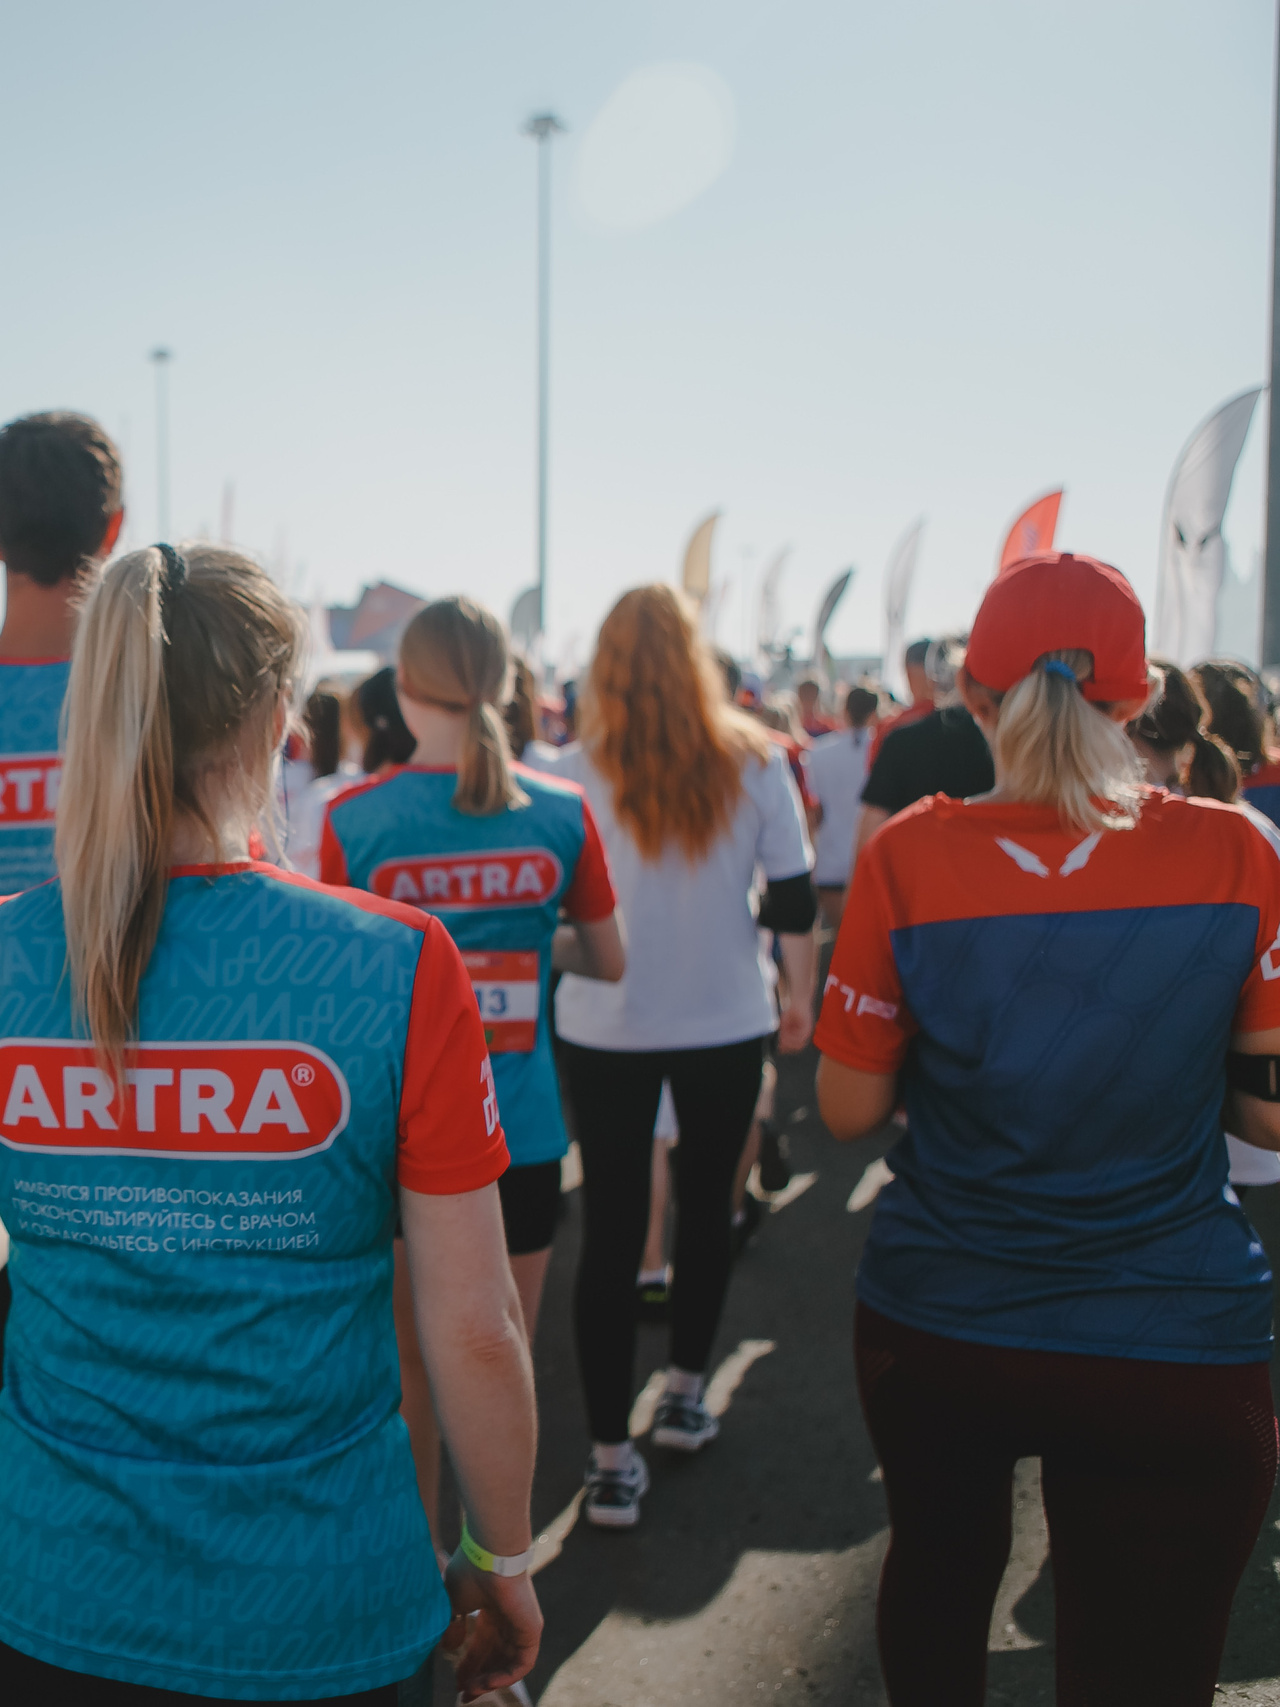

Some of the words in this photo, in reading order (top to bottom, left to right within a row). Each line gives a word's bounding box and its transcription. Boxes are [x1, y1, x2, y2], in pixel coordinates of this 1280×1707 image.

[220, 1214, 233, 1230] С
[239, 1211, 316, 1231] ВРАЧОМ
[163, 1236, 177, 1253] С
